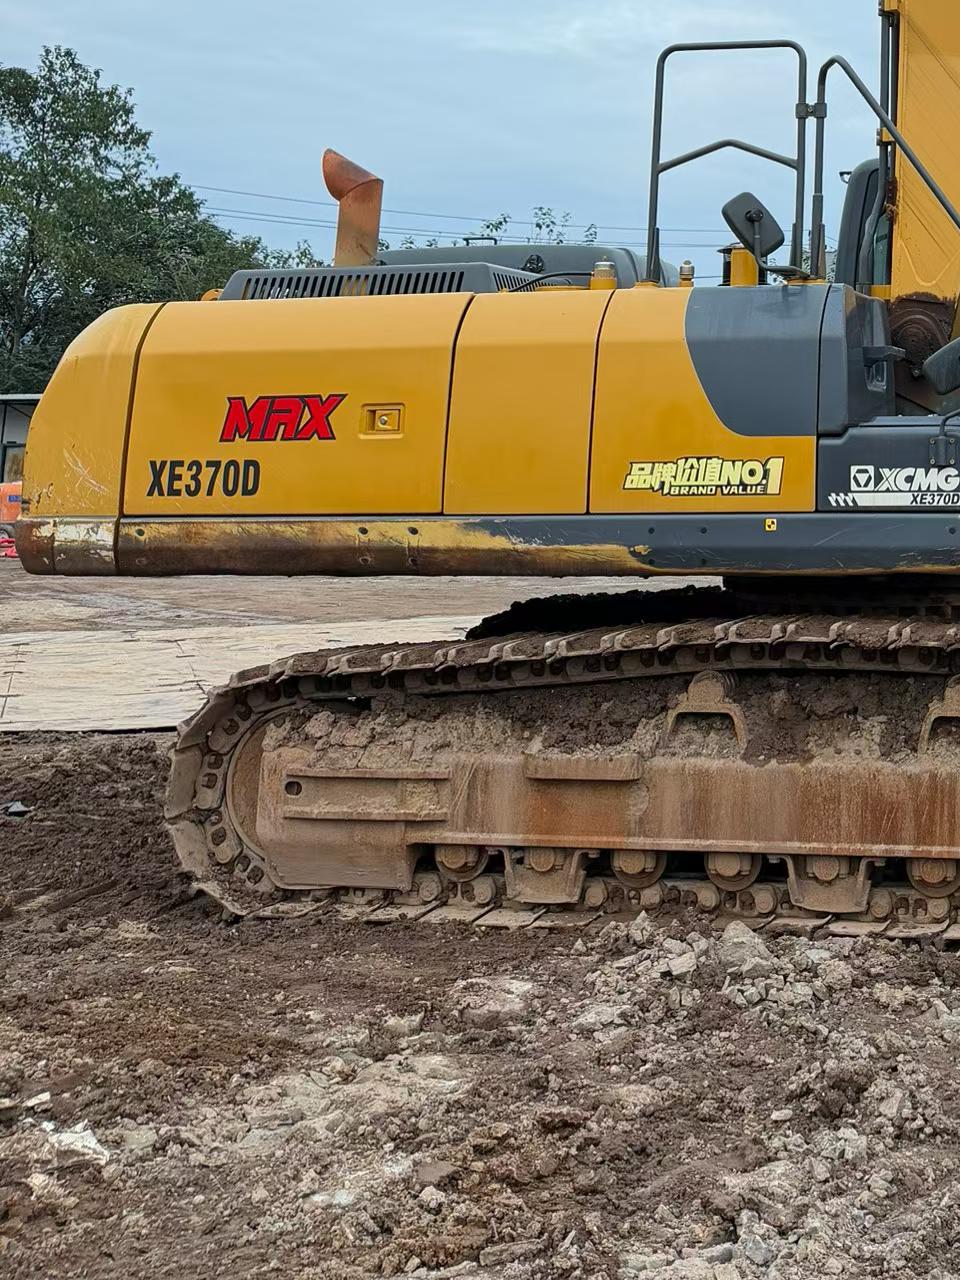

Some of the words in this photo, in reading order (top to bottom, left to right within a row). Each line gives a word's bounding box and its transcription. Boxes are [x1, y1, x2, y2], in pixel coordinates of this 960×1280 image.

[219, 393, 348, 442] MAX
[146, 459, 261, 497] XE370D
[670, 485, 717, 495] BRAND
[723, 485, 765, 495] VALUE
[875, 467, 960, 491] XCMG
[910, 493, 960, 505] XE370D
